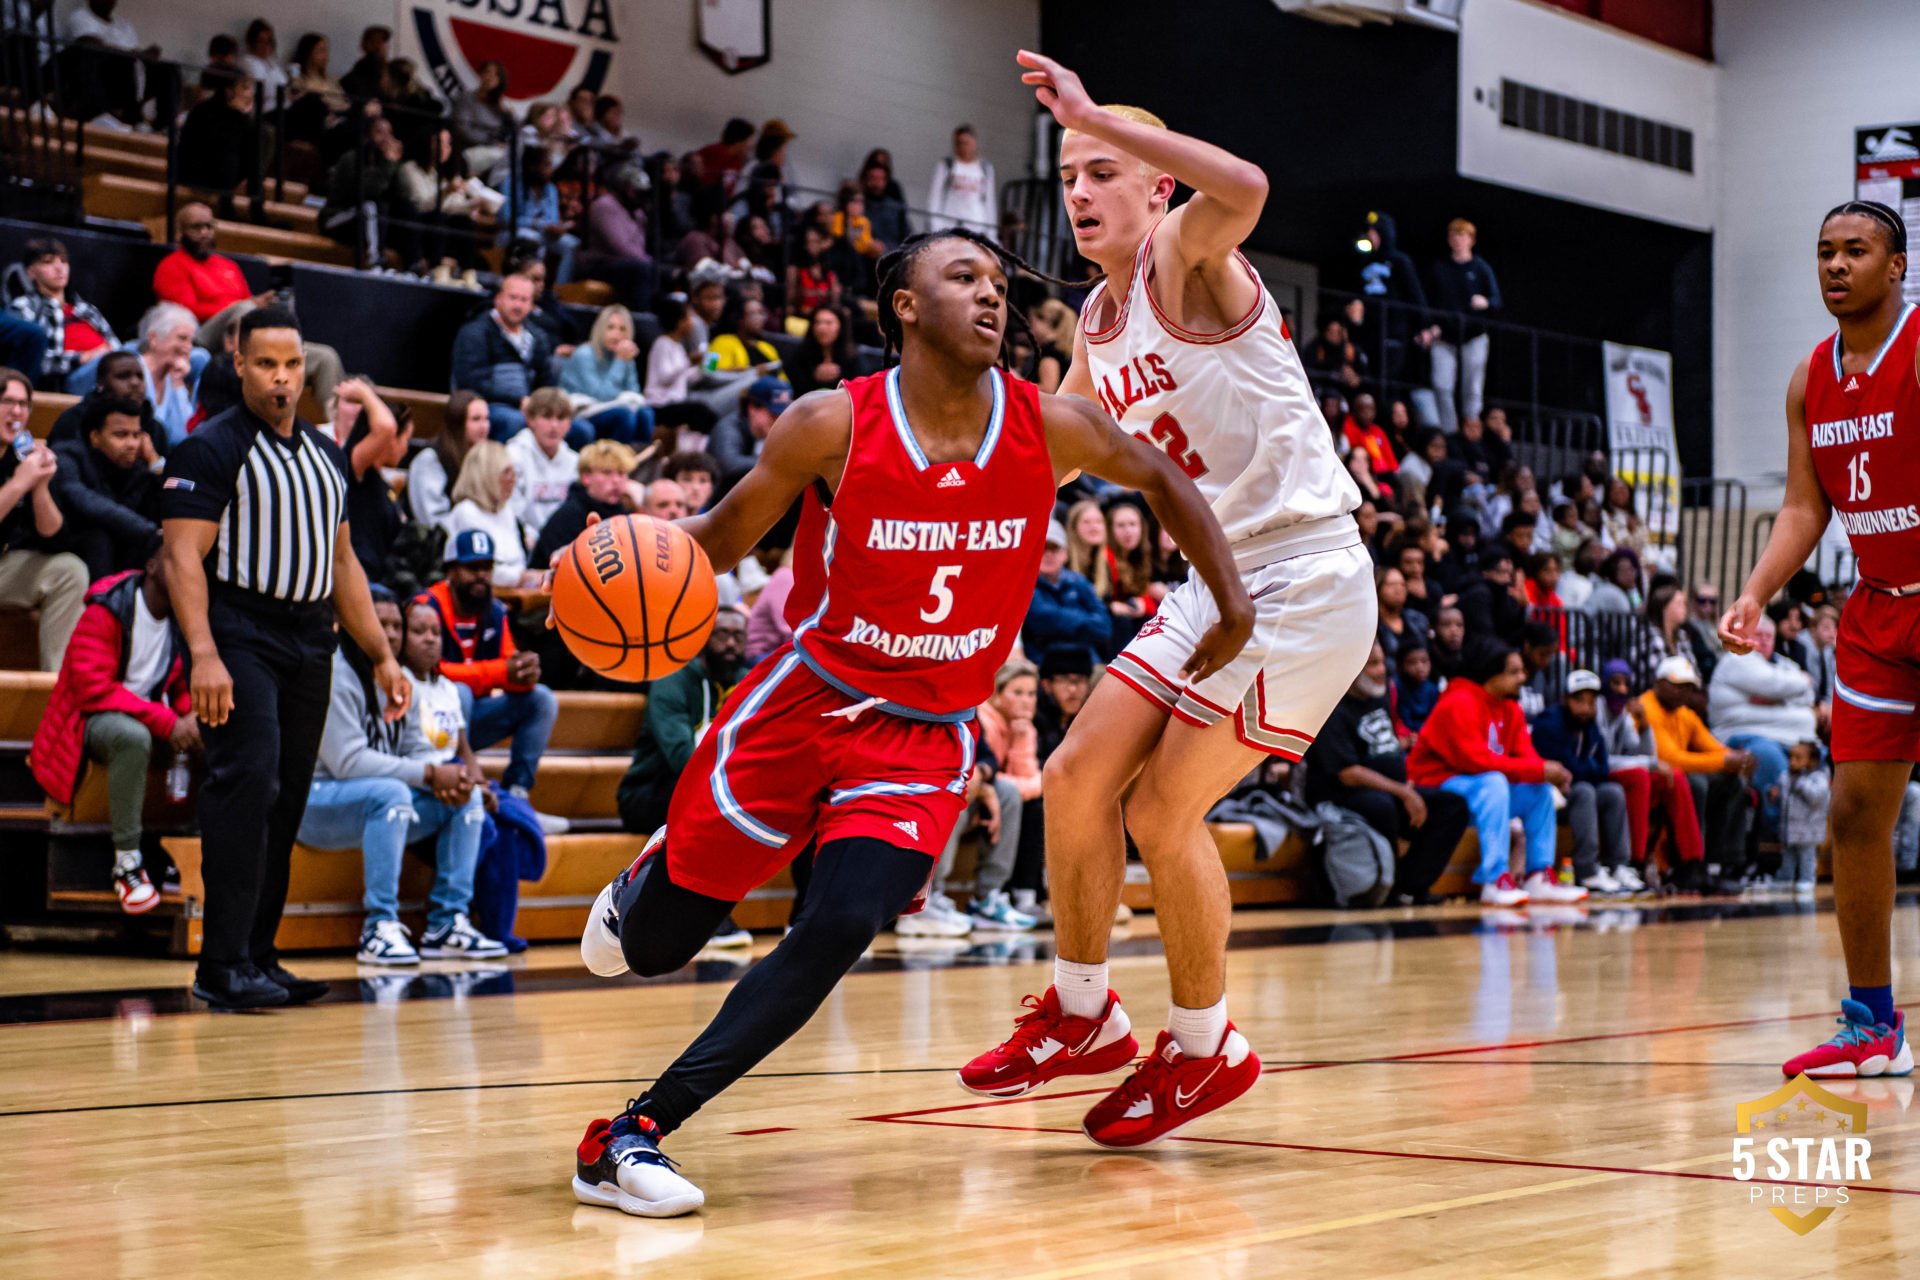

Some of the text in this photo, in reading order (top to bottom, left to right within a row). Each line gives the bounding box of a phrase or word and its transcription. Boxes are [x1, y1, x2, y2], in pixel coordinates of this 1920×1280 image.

[1133, 411, 1210, 480] 2
[1811, 411, 1895, 449] AUSTIN-EAST
[1847, 451, 1872, 502] 15
[866, 518, 1028, 551] AUSTIN-EAST
[1838, 504, 1920, 535] ADRUNNERS
[920, 565, 963, 624] 5
